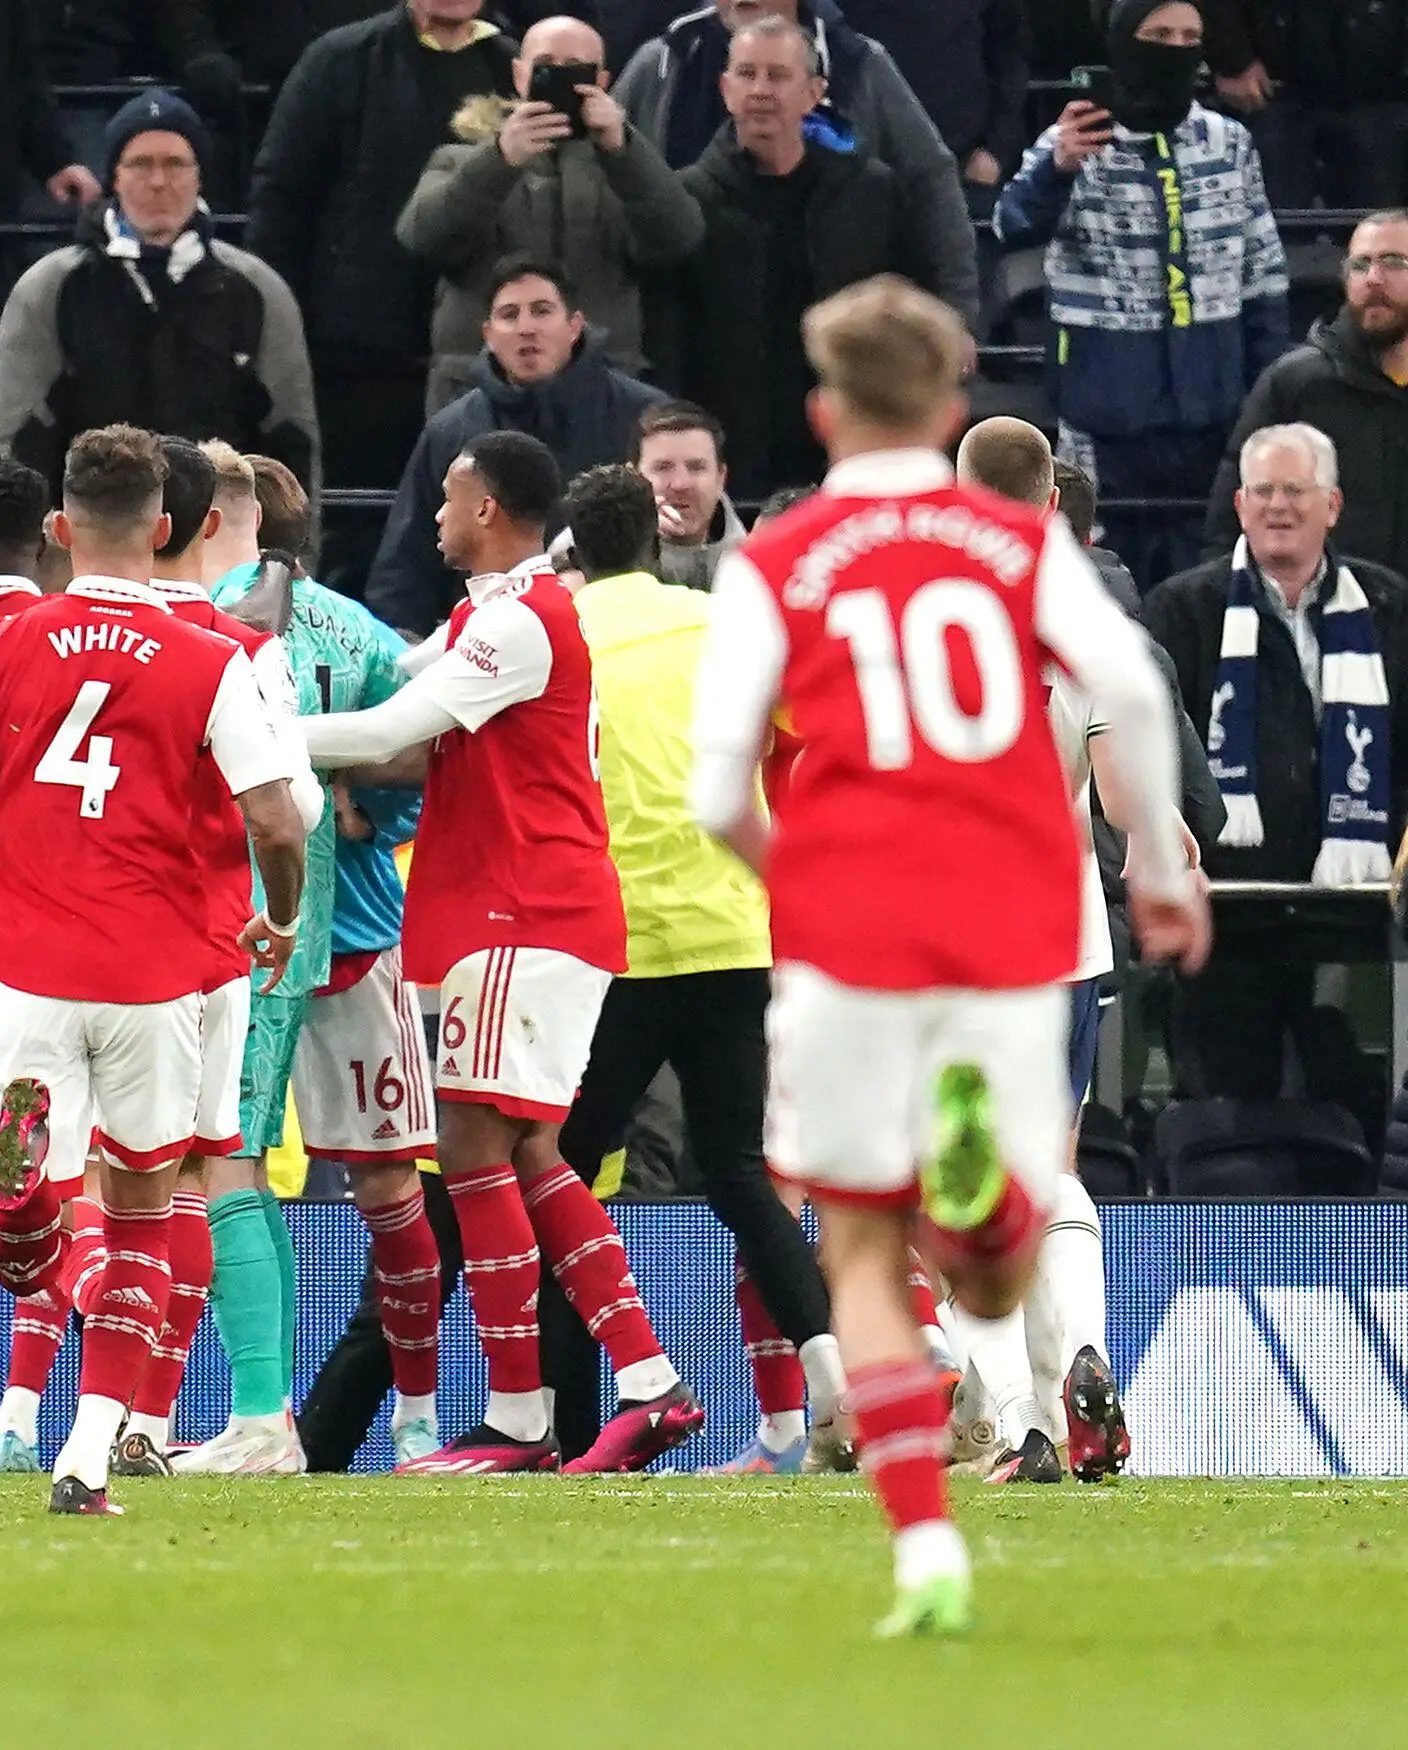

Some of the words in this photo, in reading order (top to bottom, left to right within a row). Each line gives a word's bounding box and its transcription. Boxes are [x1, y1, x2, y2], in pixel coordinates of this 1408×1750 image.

[47, 622, 163, 665] WHITE
[458, 645, 500, 679] WANDA
[468, 633, 499, 660] VISIT
[824, 575, 1026, 773] 10
[33, 680, 122, 820] 4
[443, 995, 467, 1050] 6
[349, 1055, 405, 1114] 16
[102, 1292, 159, 1314] adidas
